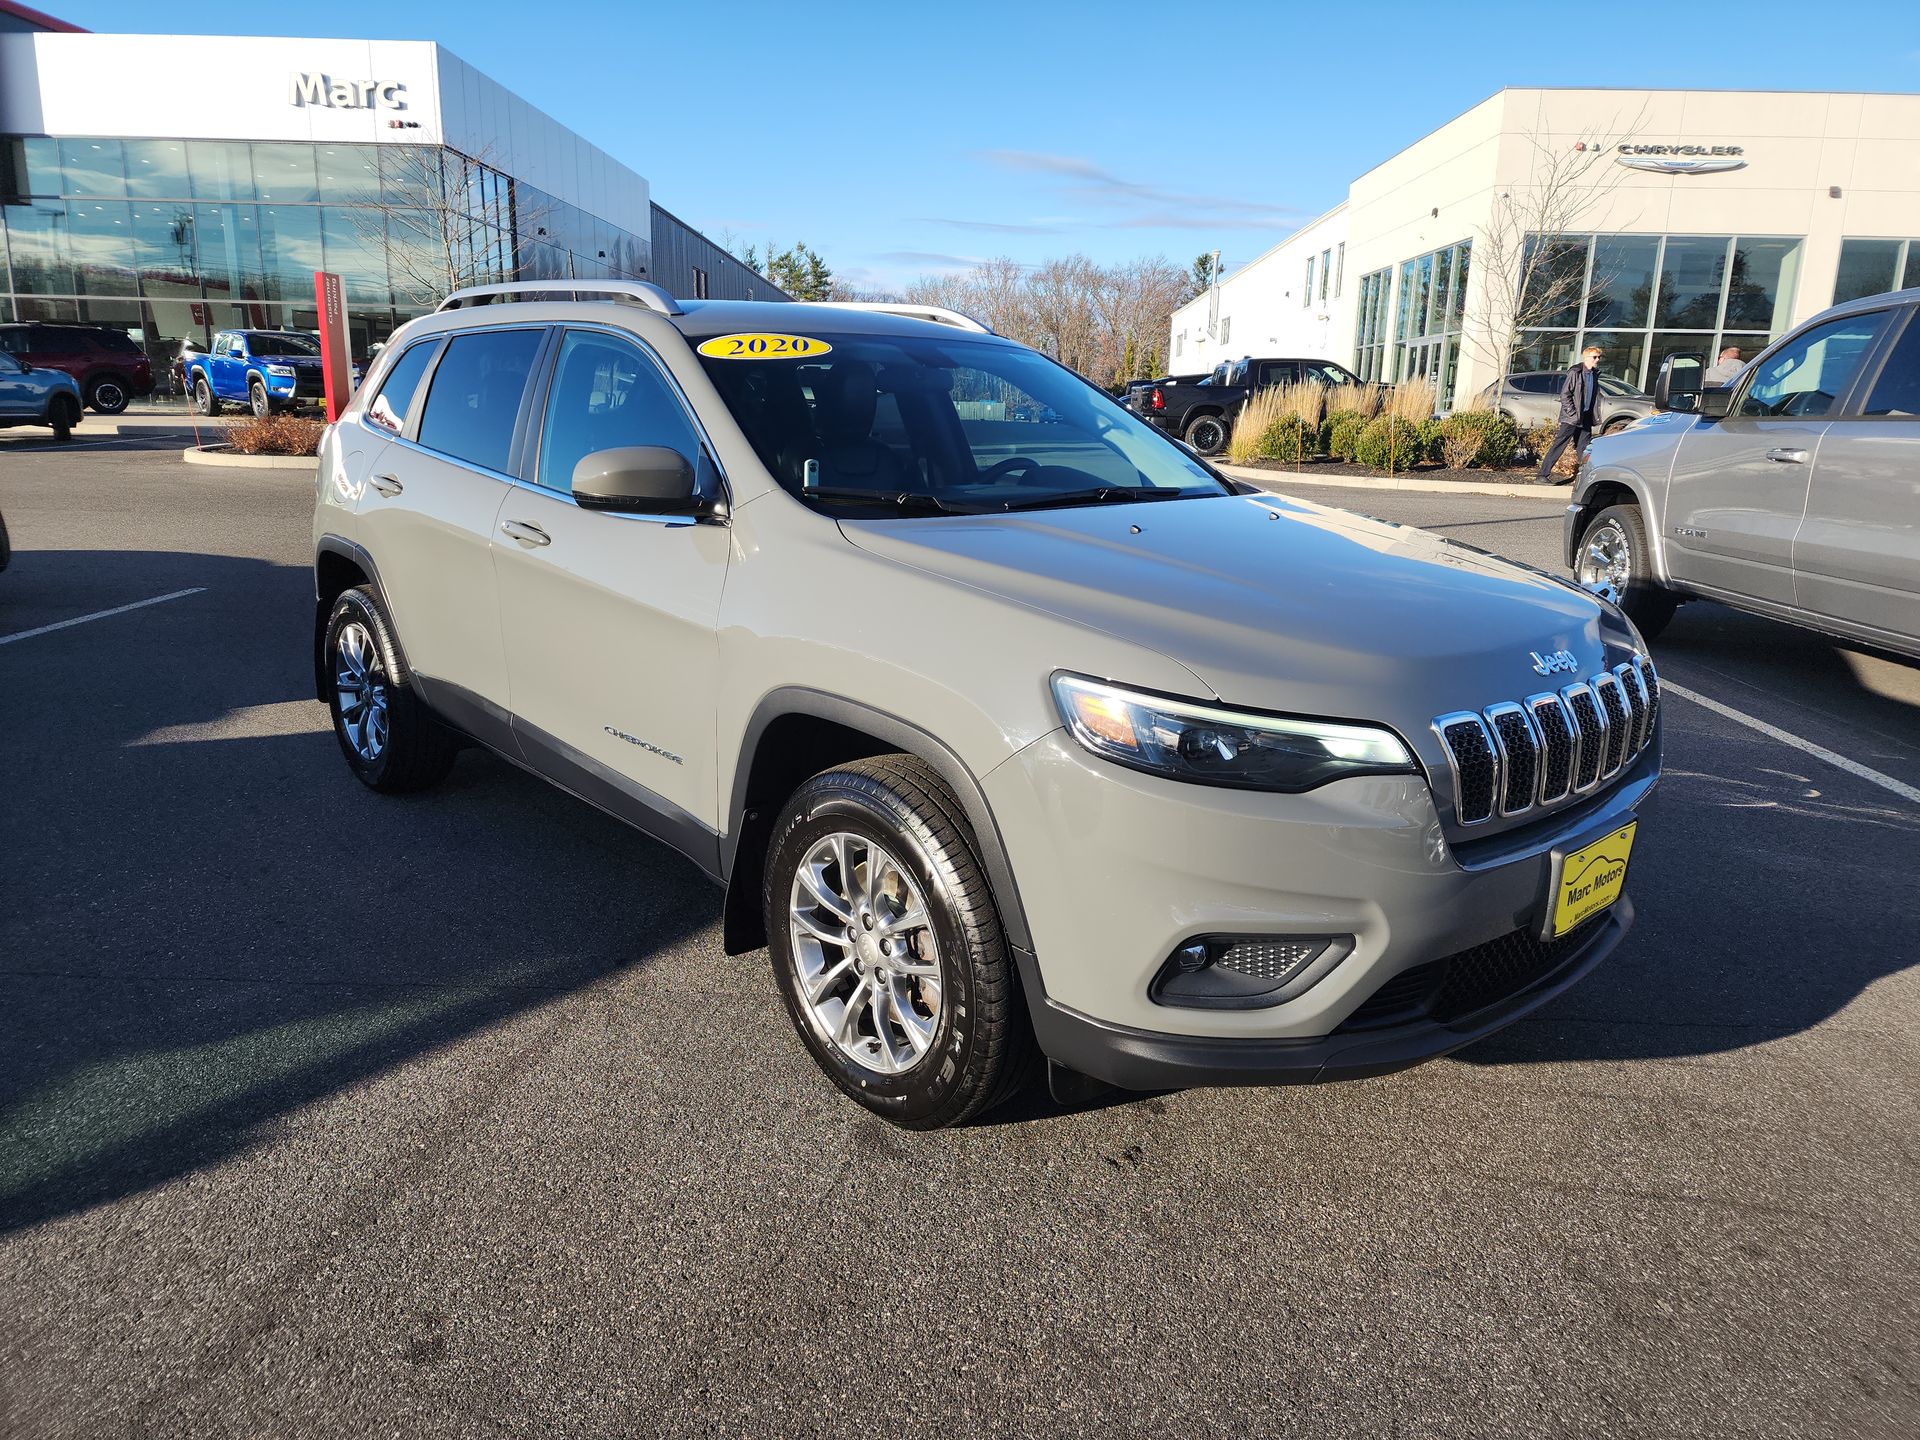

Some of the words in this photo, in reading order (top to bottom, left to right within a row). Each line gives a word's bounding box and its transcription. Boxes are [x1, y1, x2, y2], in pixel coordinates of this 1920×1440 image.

[289, 72, 408, 110] Marc
[1618, 145, 1745, 156] CHRYSLER
[727, 338, 810, 356] 2020
[1529, 650, 1578, 676] Jeep
[604, 726, 684, 766] CHEROKEE
[1567, 884, 1592, 906] Marc
[1593, 865, 1623, 891] Motors
